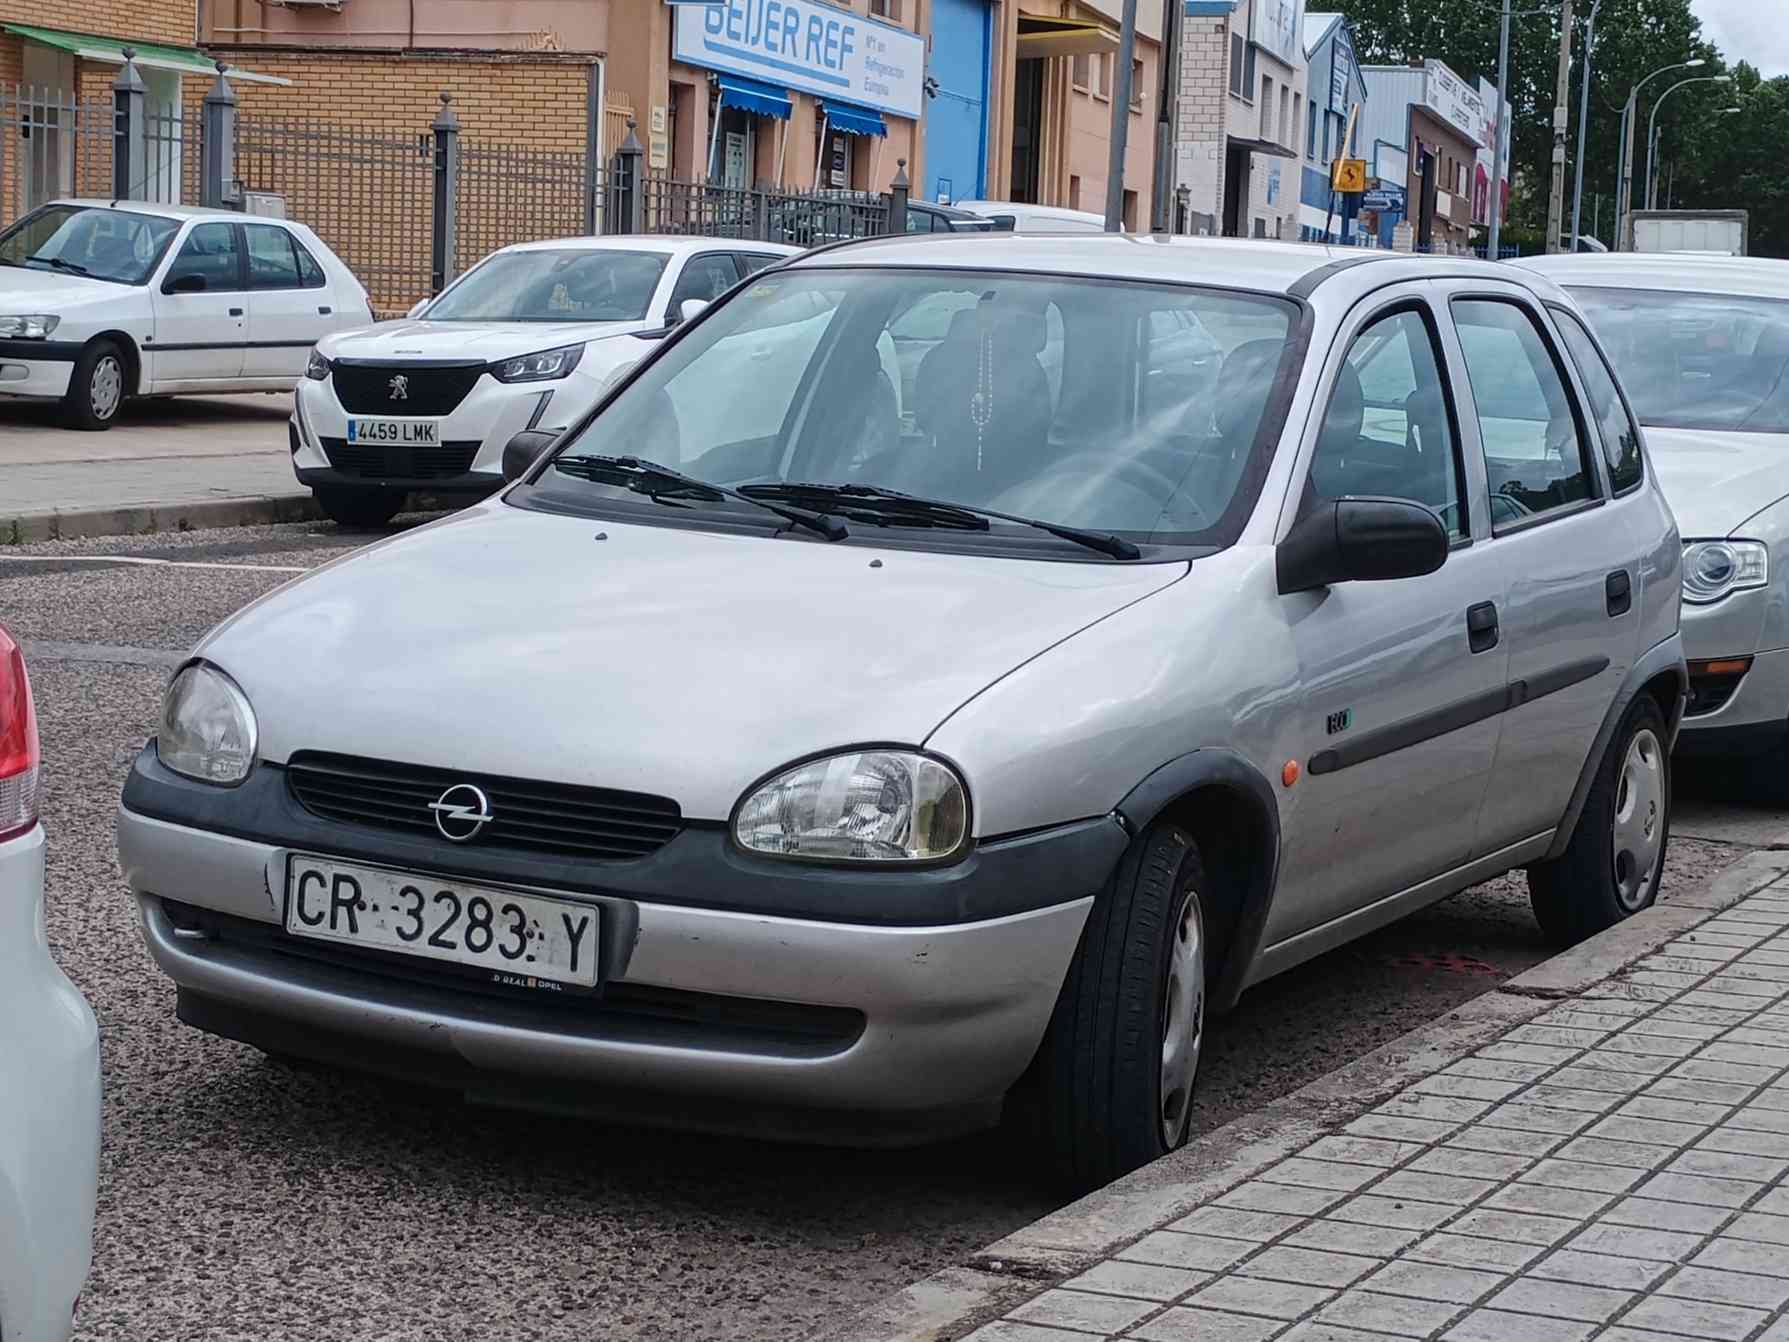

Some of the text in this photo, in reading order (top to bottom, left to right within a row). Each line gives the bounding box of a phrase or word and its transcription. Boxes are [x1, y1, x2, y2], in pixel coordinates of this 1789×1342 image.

[704, 0, 855, 71] BEIJER REF
[359, 422, 434, 441] 4459 LMK
[297, 869, 590, 972] CR 3283 Y
[537, 980, 562, 991] OPEL
